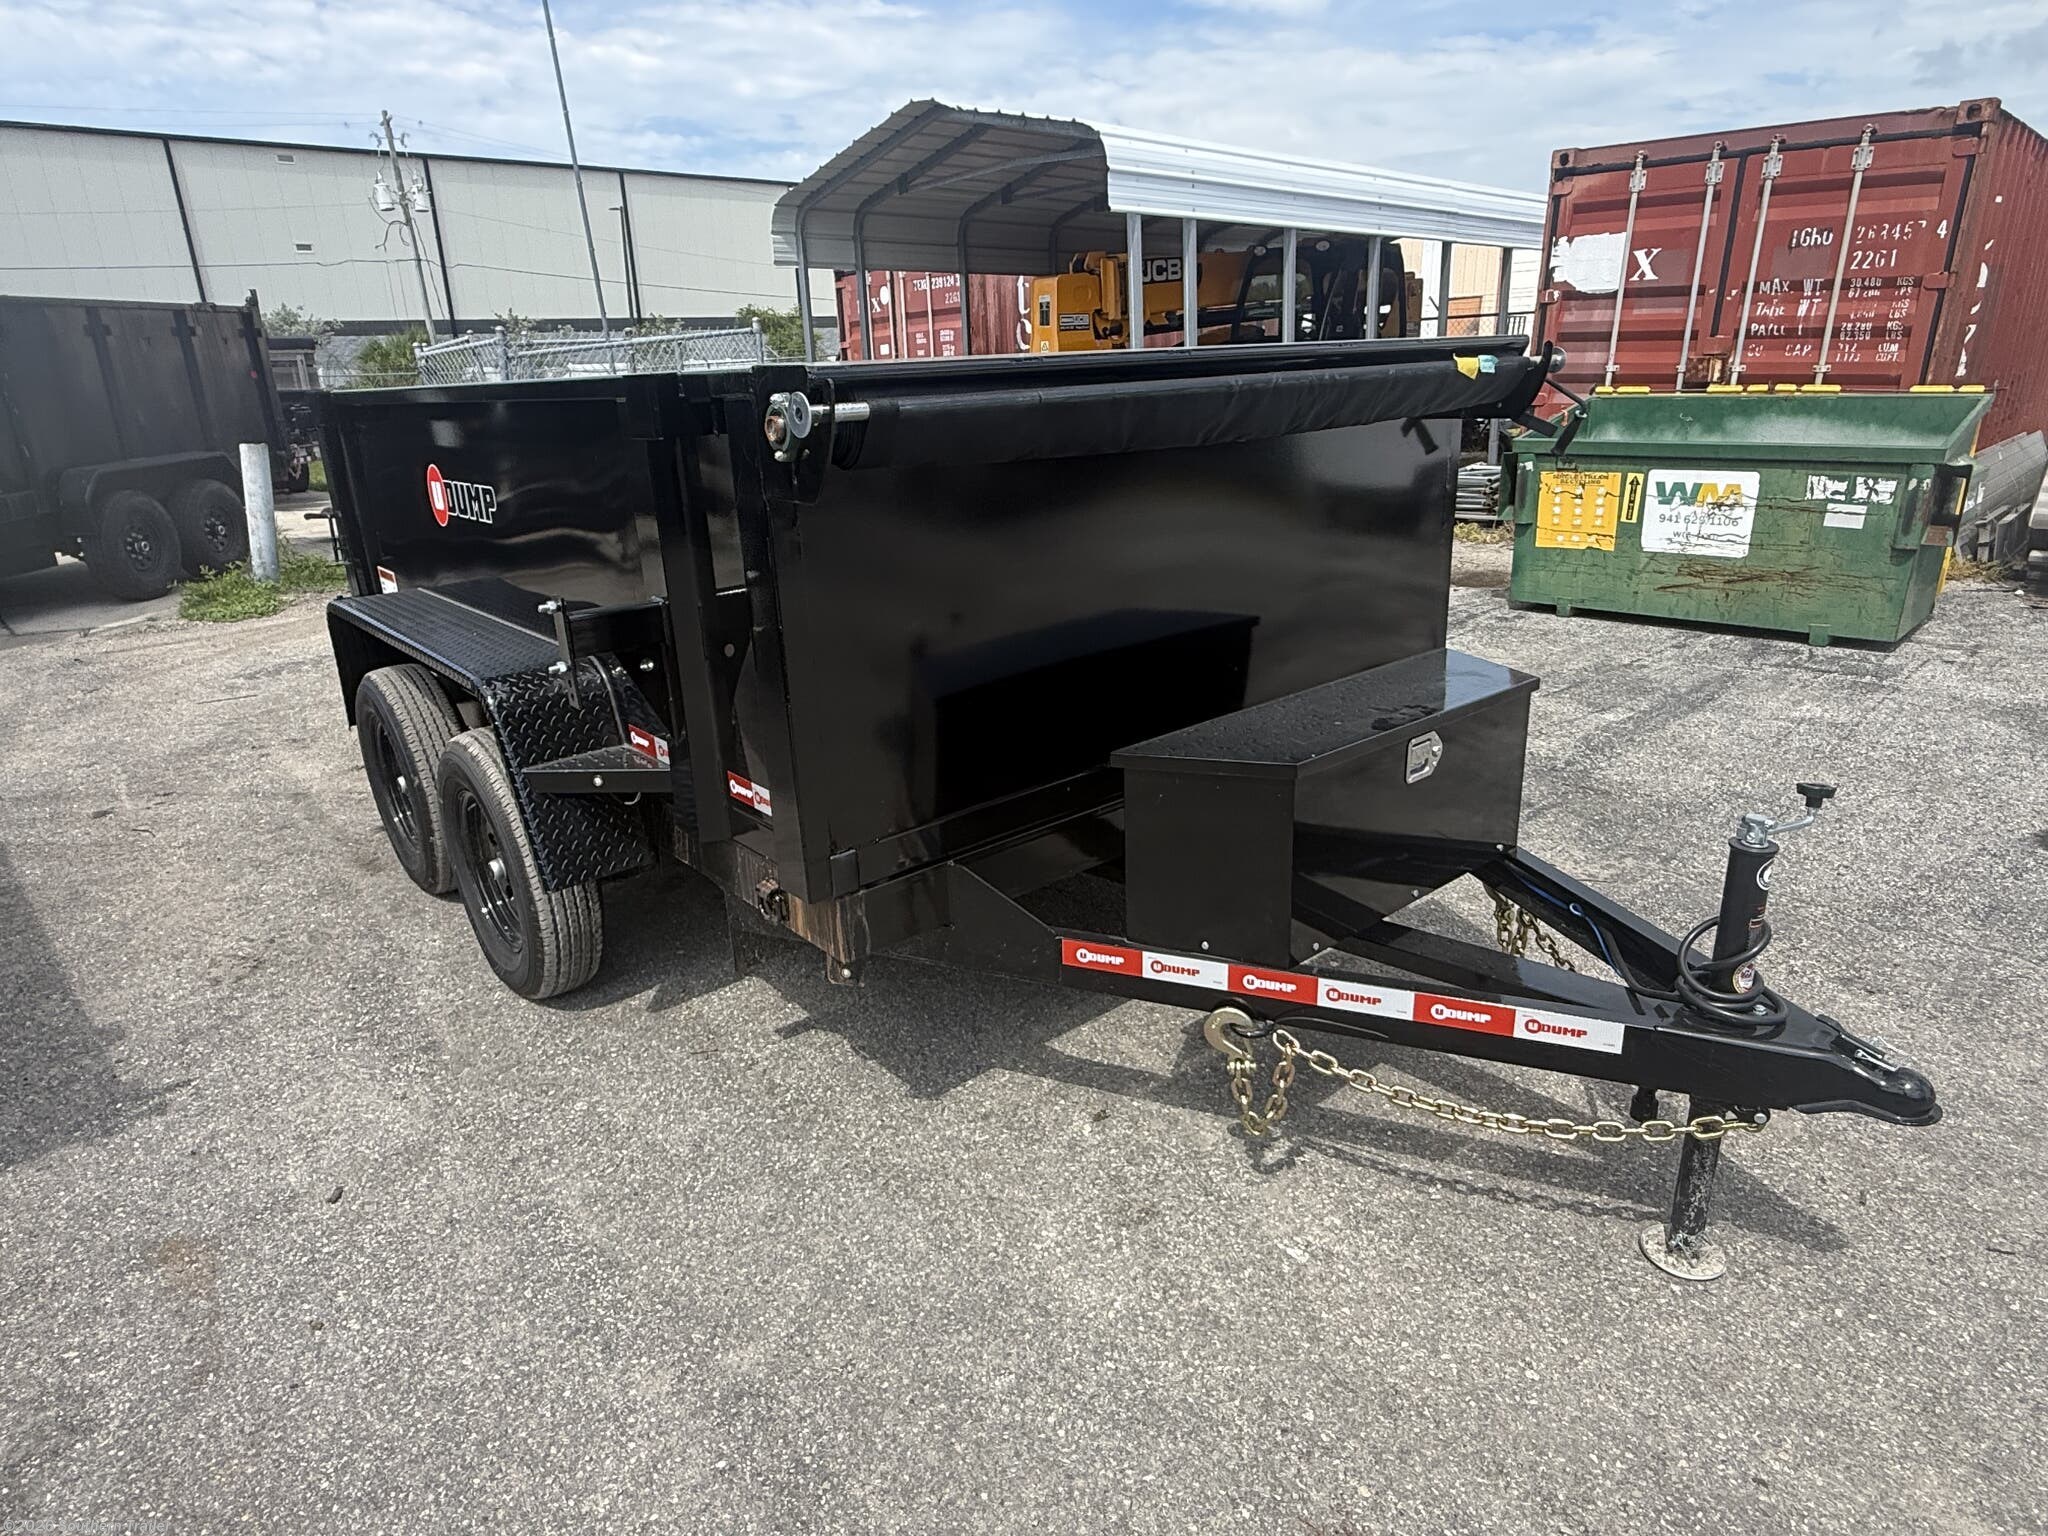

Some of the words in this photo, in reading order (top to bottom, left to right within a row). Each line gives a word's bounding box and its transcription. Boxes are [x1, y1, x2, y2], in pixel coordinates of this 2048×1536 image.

[1936, 219, 1949, 239] 4
[1143, 259, 1182, 282] JCB
[427, 464, 497, 526] UDUMP
[1656, 481, 1743, 508] WM
[1659, 513, 1680, 524] 941
[1076, 948, 1125, 966] UDUMP
[1150, 960, 1200, 977] UDUMP
[1242, 974, 1297, 993] UDUMP
[1326, 987, 1382, 1006] UDUMP
[1430, 1003, 1492, 1024] UDUMP
[1524, 1018, 1588, 1038] UDUMP
